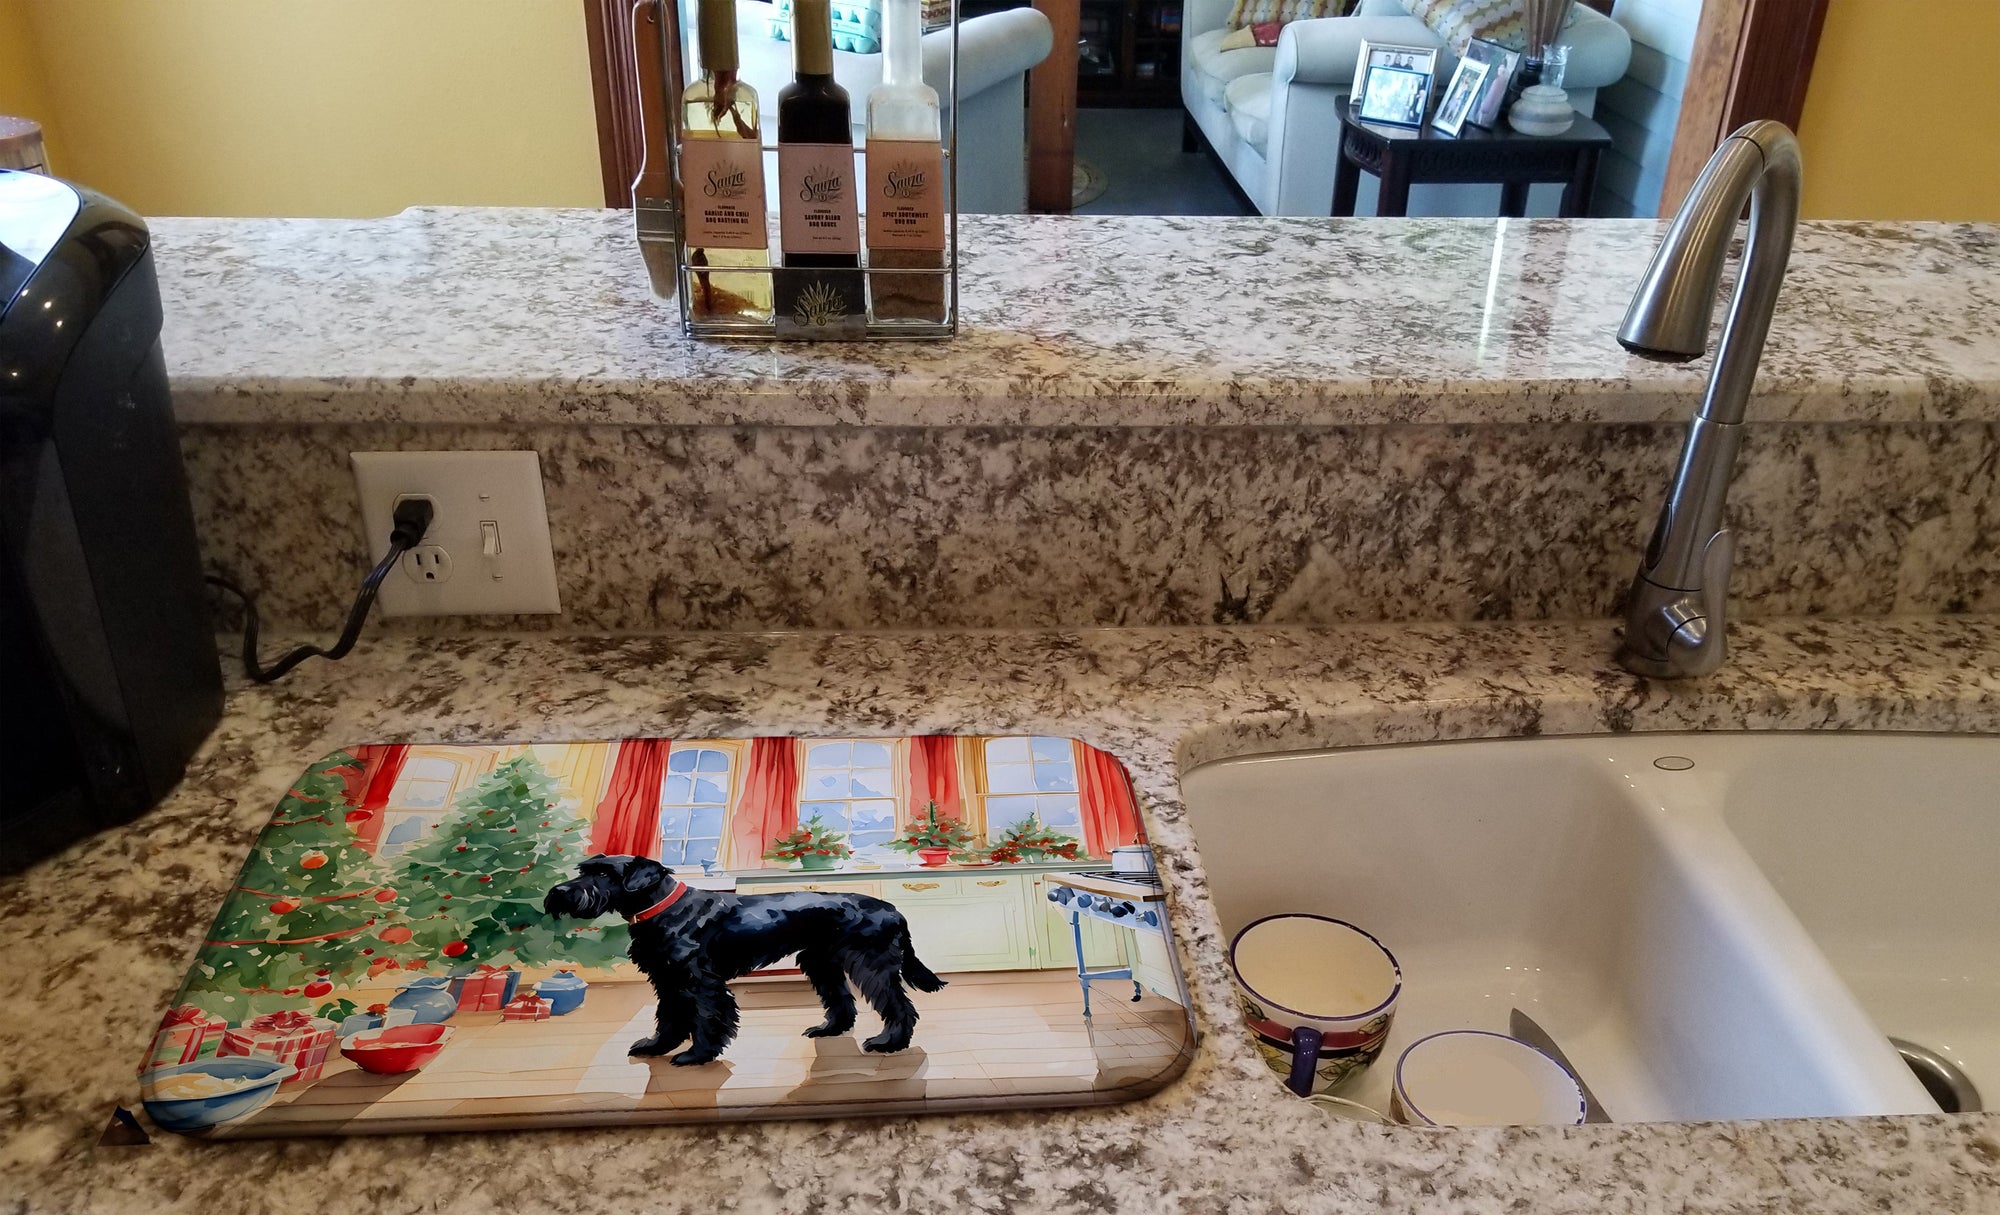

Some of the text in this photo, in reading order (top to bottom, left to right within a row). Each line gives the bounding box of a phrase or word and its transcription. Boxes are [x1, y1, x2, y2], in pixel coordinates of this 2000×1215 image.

[704, 170, 745, 197] Sauza
[800, 175, 841, 201] Sauza
[884, 171, 925, 198] Sauza
